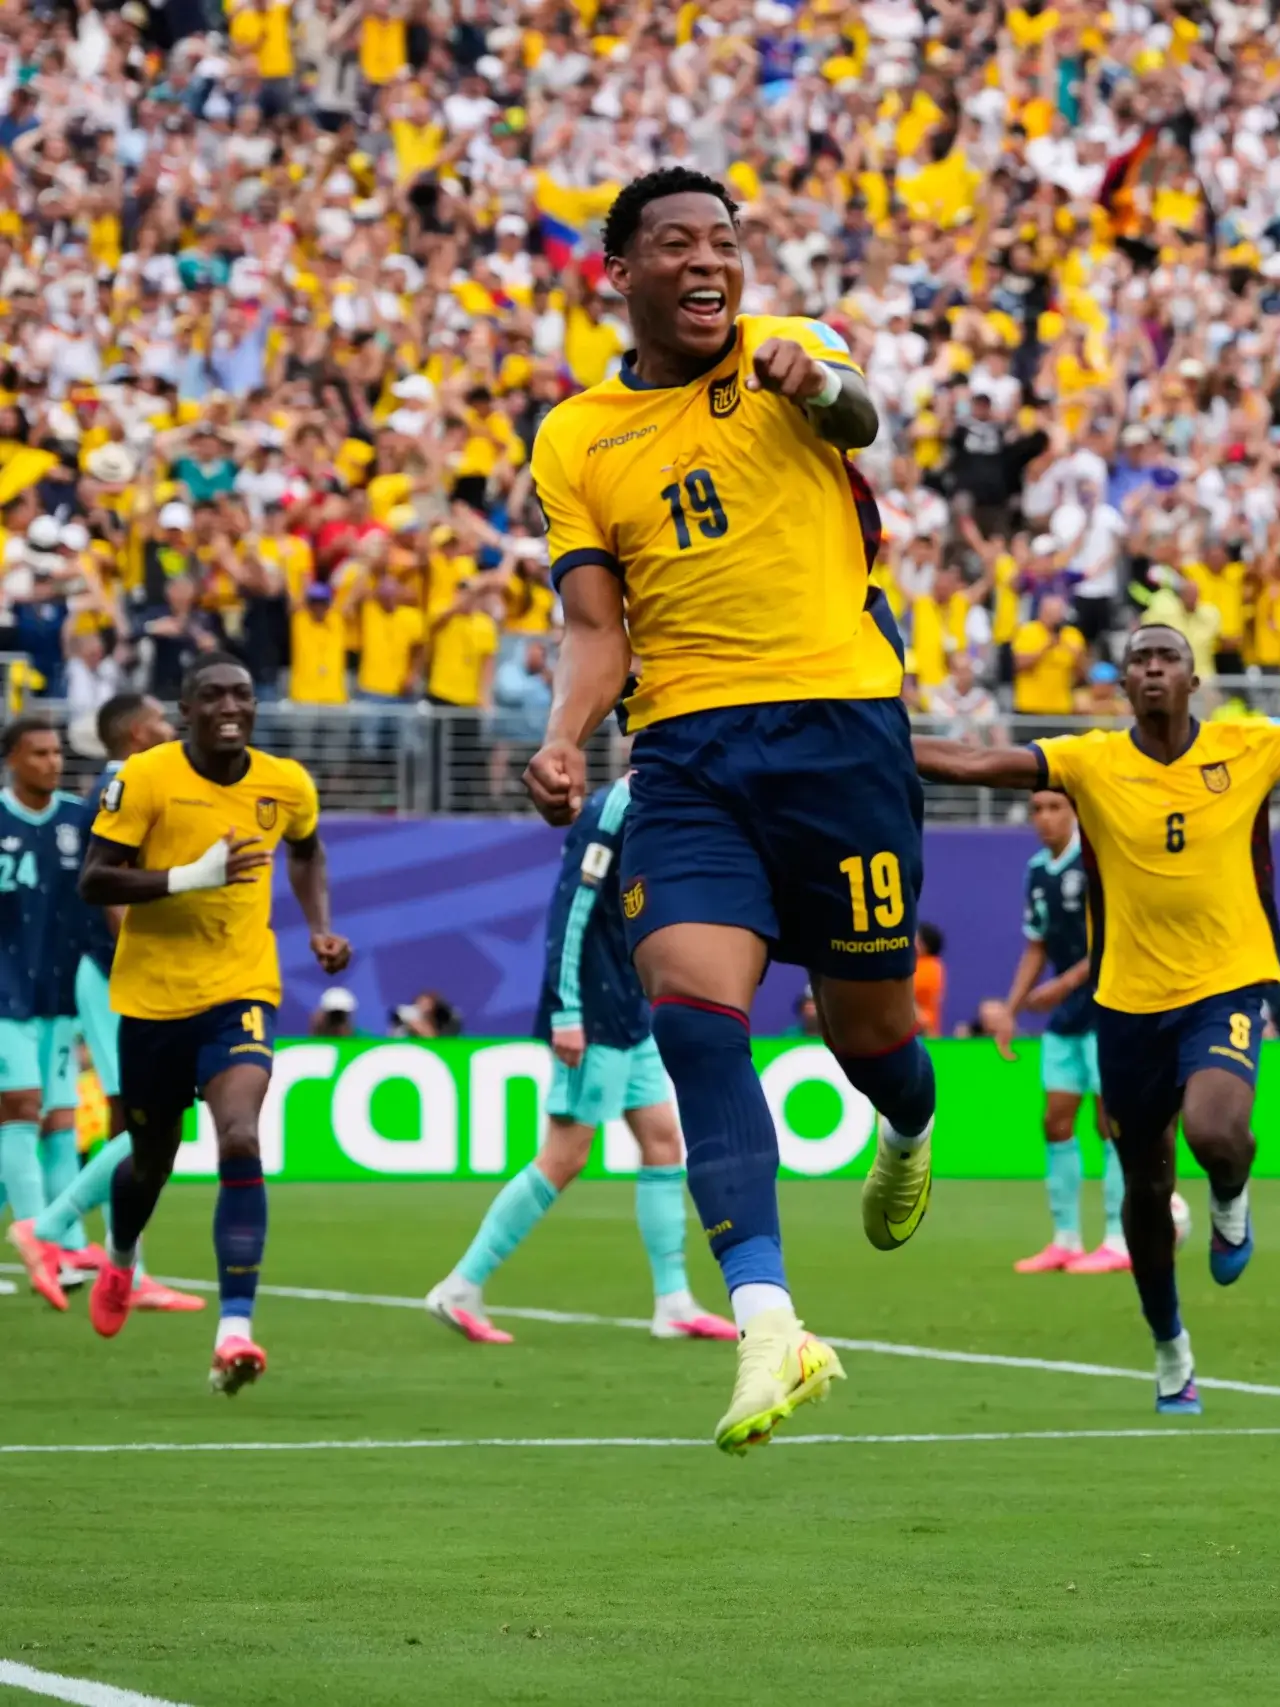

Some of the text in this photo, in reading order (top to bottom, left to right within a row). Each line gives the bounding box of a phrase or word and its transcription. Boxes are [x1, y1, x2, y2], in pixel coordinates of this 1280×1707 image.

[661, 468, 728, 550] 19
[1166, 812, 1185, 854] 6
[0, 852, 38, 891] 24
[839, 851, 904, 932] 19
[831, 936, 909, 953] marathon
[241, 1005, 264, 1041] 4
